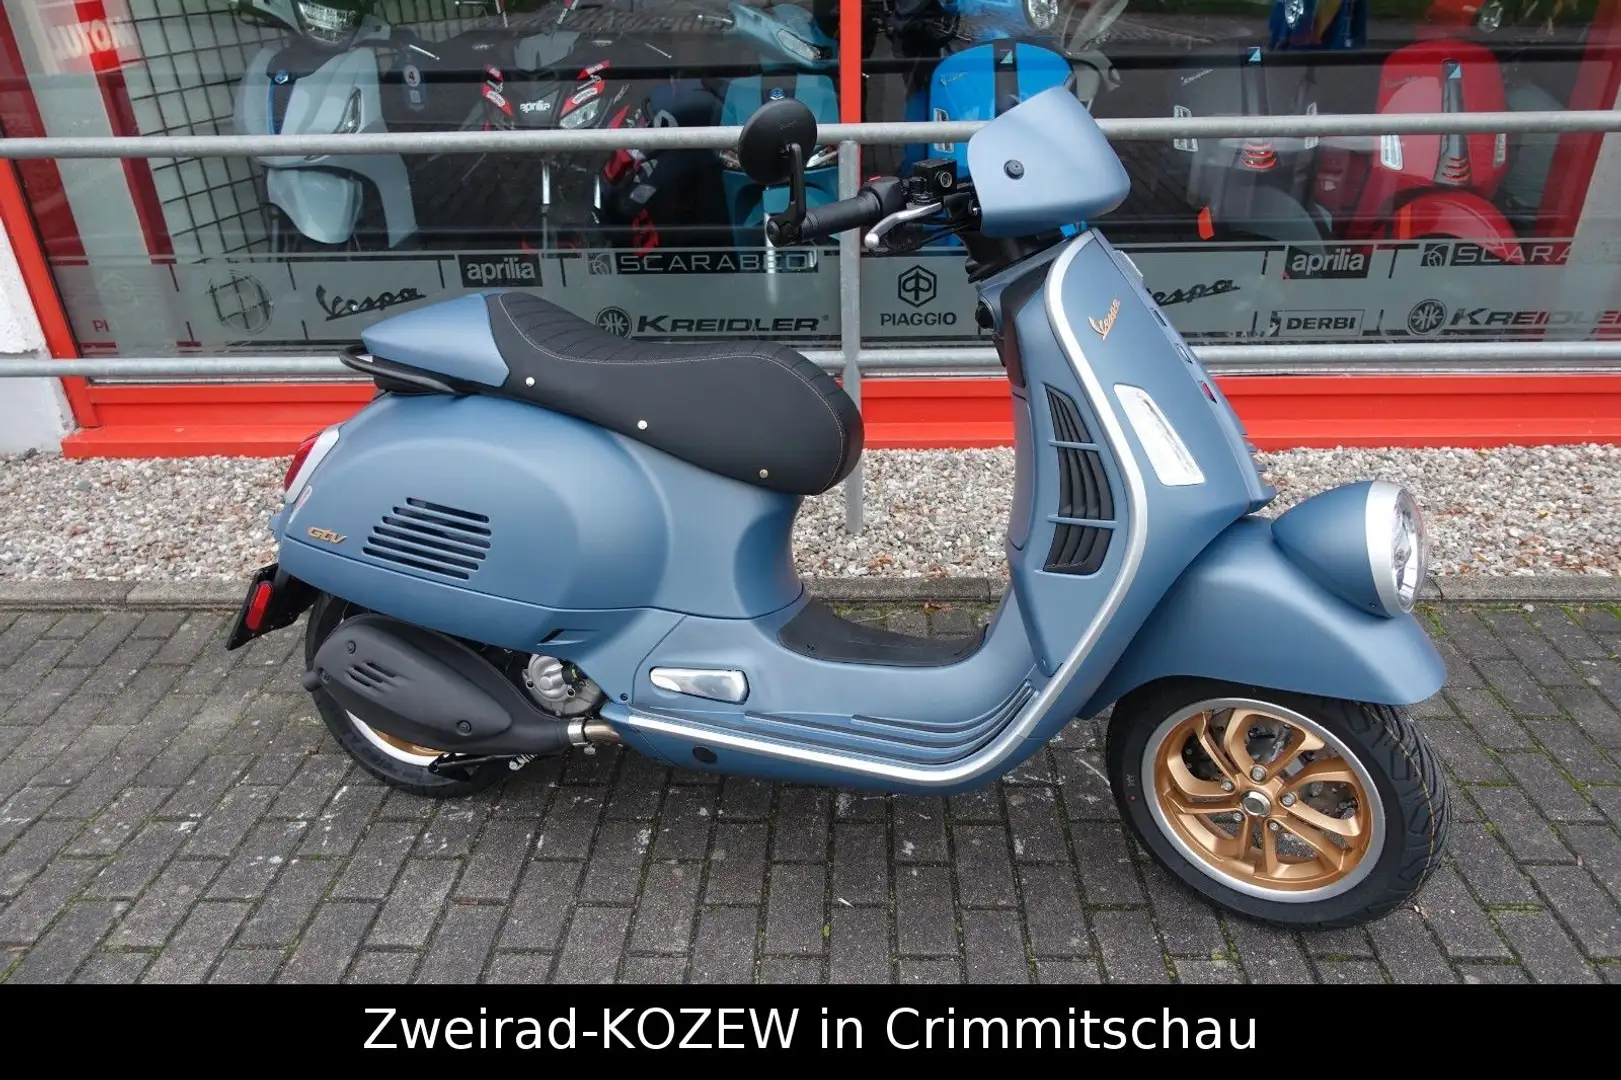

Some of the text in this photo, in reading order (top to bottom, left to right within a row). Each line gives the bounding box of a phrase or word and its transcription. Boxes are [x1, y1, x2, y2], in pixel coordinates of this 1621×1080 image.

[466, 257, 536, 284] aprilia
[1291, 248, 1365, 275] aprilia
[315, 284, 427, 321] Vespa
[1146, 279, 1241, 307] espa
[637, 315, 820, 333] KREIDLER
[879, 311, 958, 327] PIAGGIO
[1286, 317, 1356, 330] DERBI
